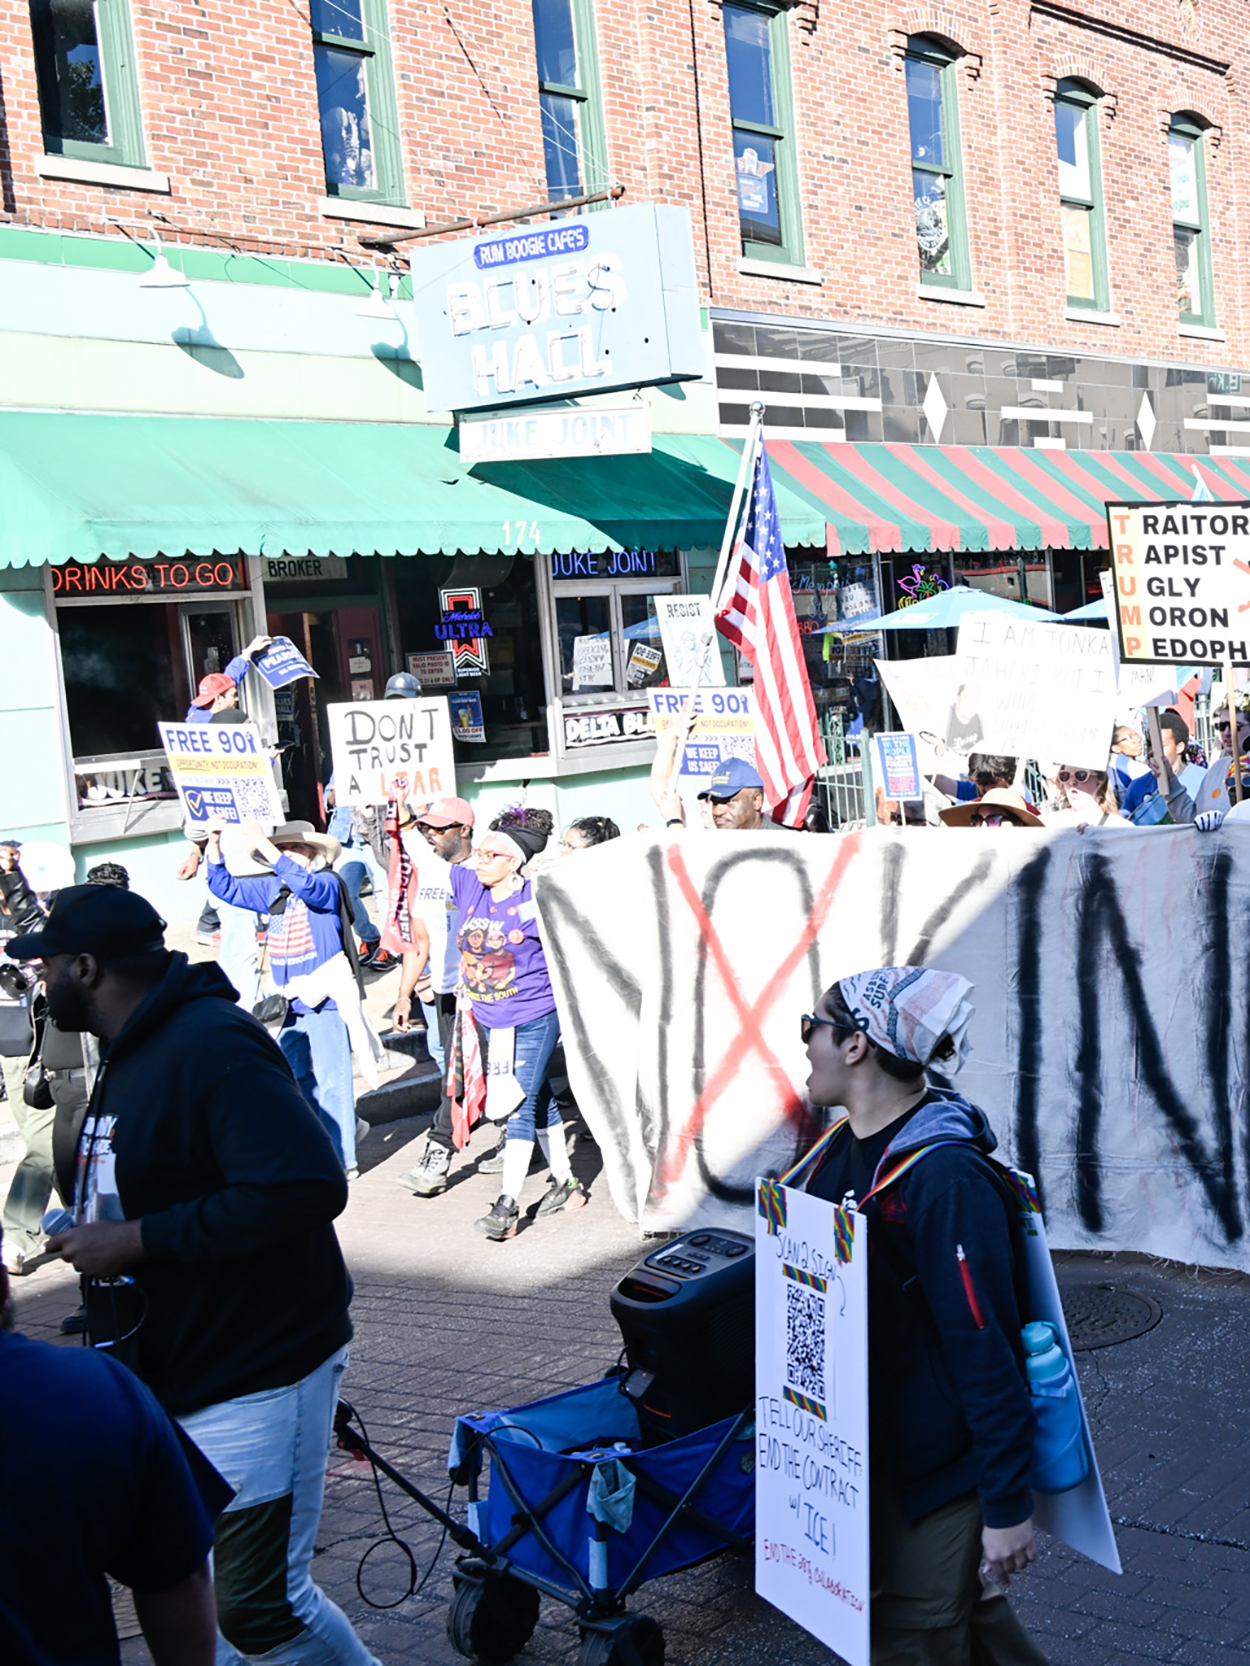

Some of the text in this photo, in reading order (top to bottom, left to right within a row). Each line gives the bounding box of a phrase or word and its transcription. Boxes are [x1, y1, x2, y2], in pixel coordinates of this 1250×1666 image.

[480, 227, 585, 266] RUM BOOGIE CAFE'S
[447, 252, 626, 337] BLUES
[471, 325, 613, 397] HALL
[477, 413, 633, 450] JUKE JOINT
[501, 521, 541, 546] 174
[50, 562, 234, 591] DRINKS TO GO
[267, 558, 322, 579] BROKER
[551, 552, 598, 577] JUKE
[666, 603, 701, 618] RESIST
[434, 620, 494, 641] ULTRA
[1002, 624, 1036, 646] AM
[344, 703, 439, 747] DON'T
[565, 713, 621, 741] DELTA
[712, 719, 749, 728] OCCUPATION!
[165, 729, 213, 753] FREE
[686, 747, 719, 759] WE KEEP
[210, 760, 259, 770] NOT OCCUPATION!
[348, 742, 428, 771] TRUST
[687, 761, 698, 772] US
[88, 767, 162, 801] JUKE
[349, 766, 443, 797] A LAR
[201, 791, 232, 805] WE KEEP
[776, 1231, 838, 1282] SCAN 2 SIGN
[758, 1395, 792, 1429] TELL
[793, 1408, 816, 1444] OUR
[759, 1432, 859, 1509] END THE CONTRACT
[764, 1538, 779, 1562] END
[779, 1542, 797, 1567] THE
